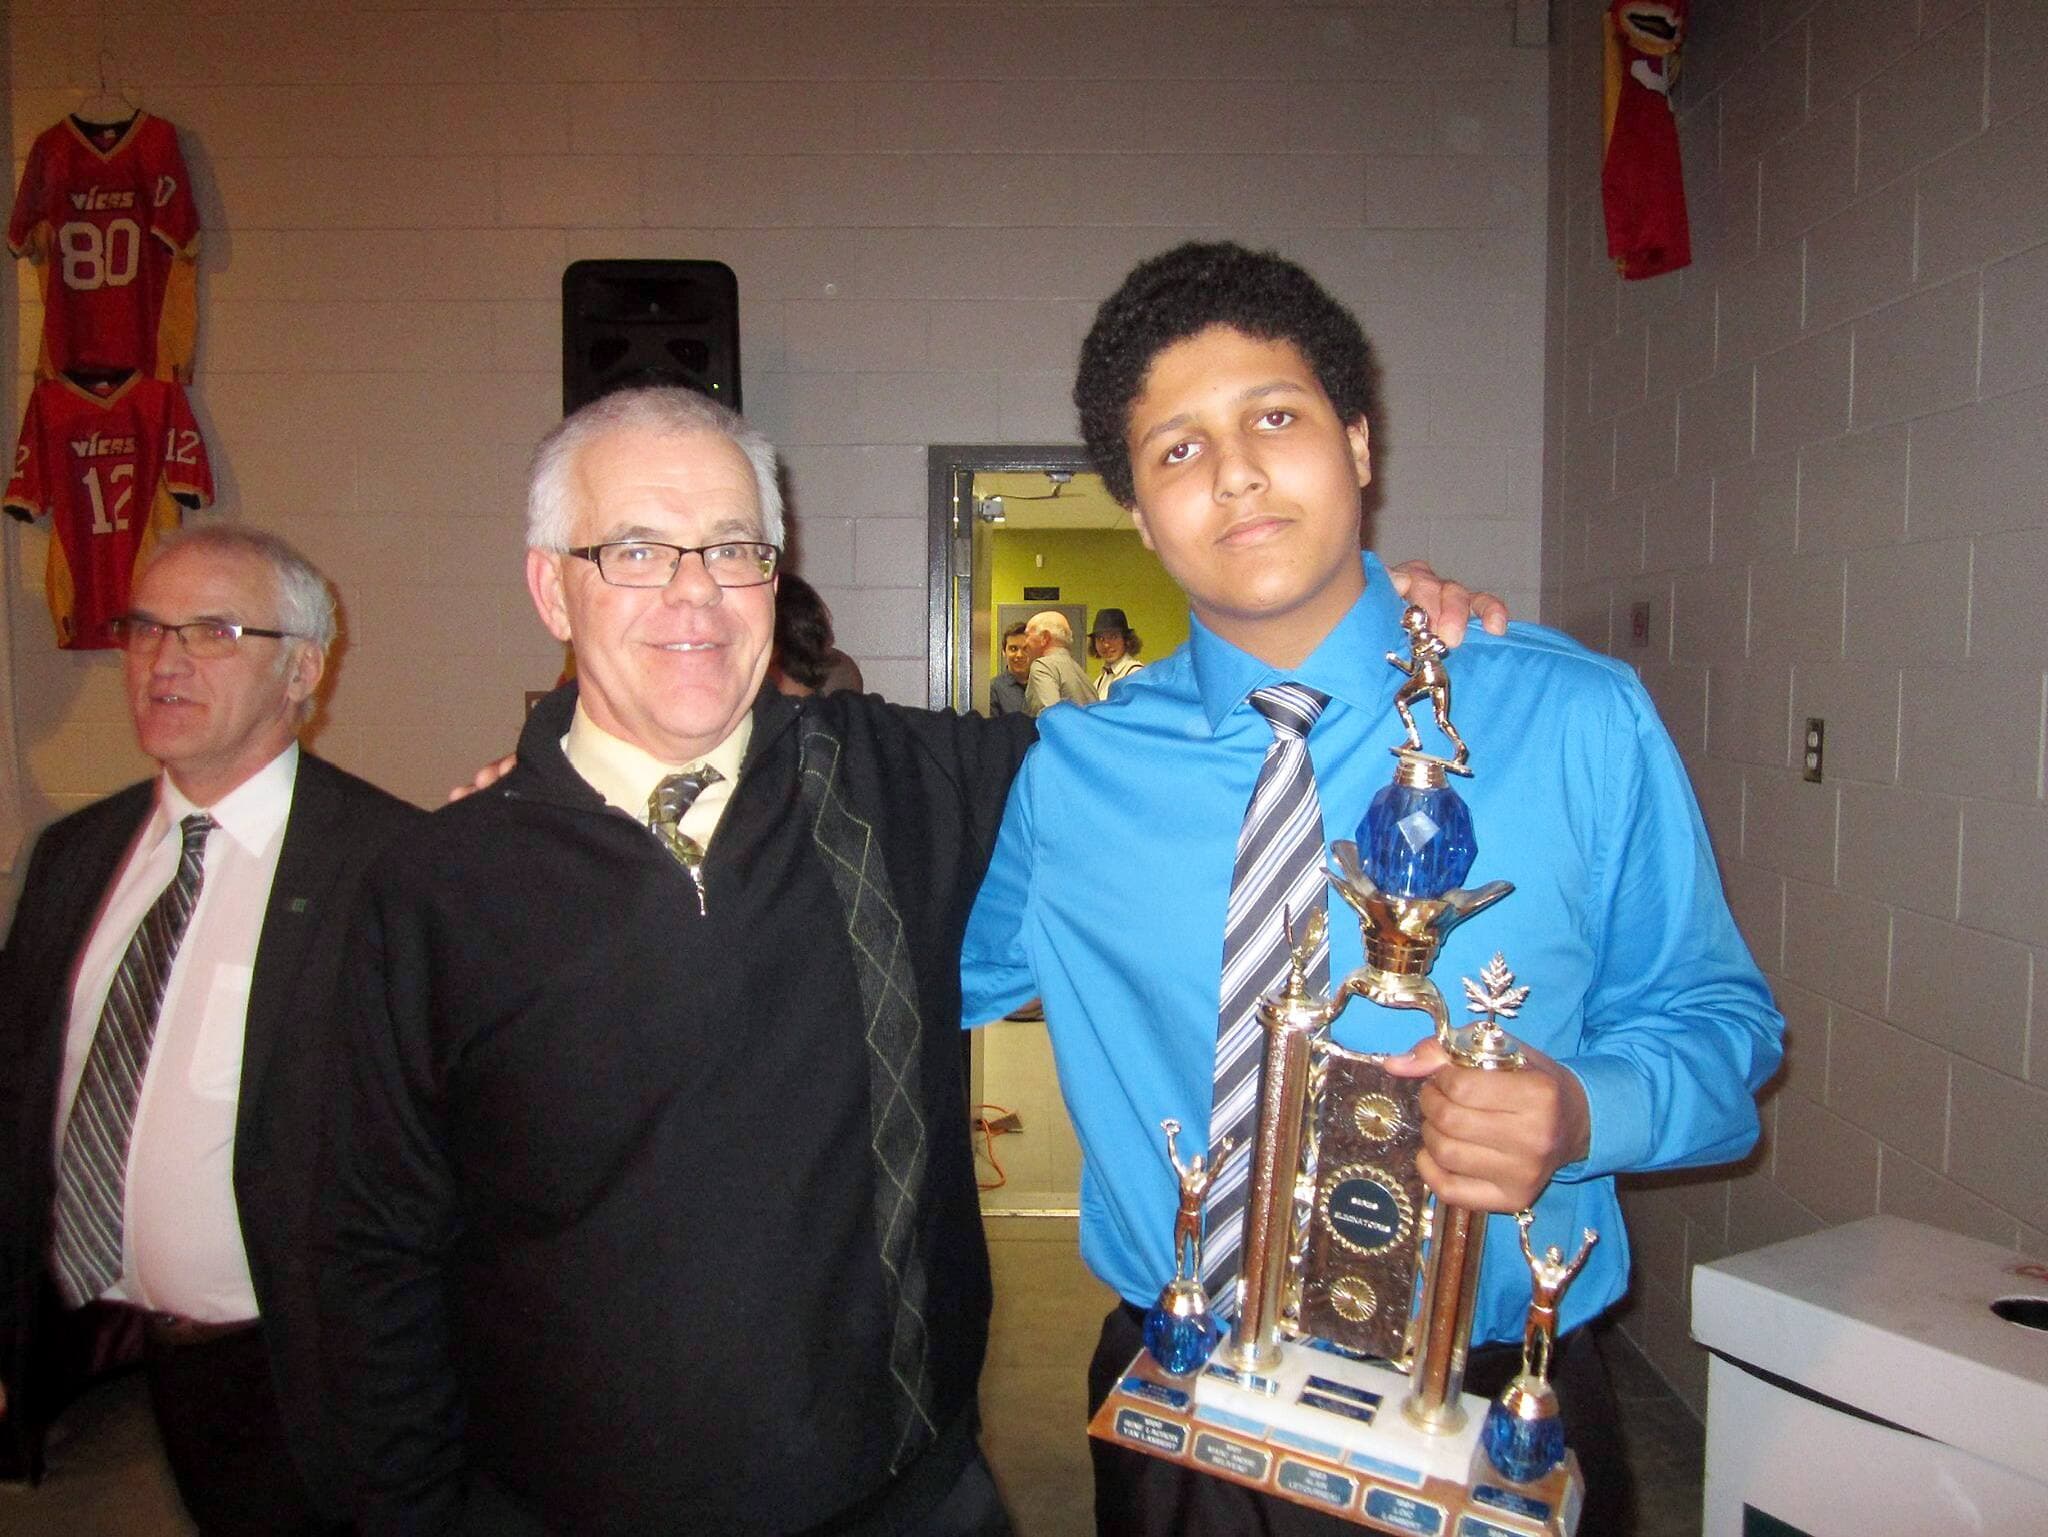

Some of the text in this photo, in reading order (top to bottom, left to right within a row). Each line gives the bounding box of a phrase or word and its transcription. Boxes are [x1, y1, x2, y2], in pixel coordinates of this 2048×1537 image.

[59, 219, 141, 291] 80
[165, 427, 200, 465] 12
[81, 463, 134, 535] 12
